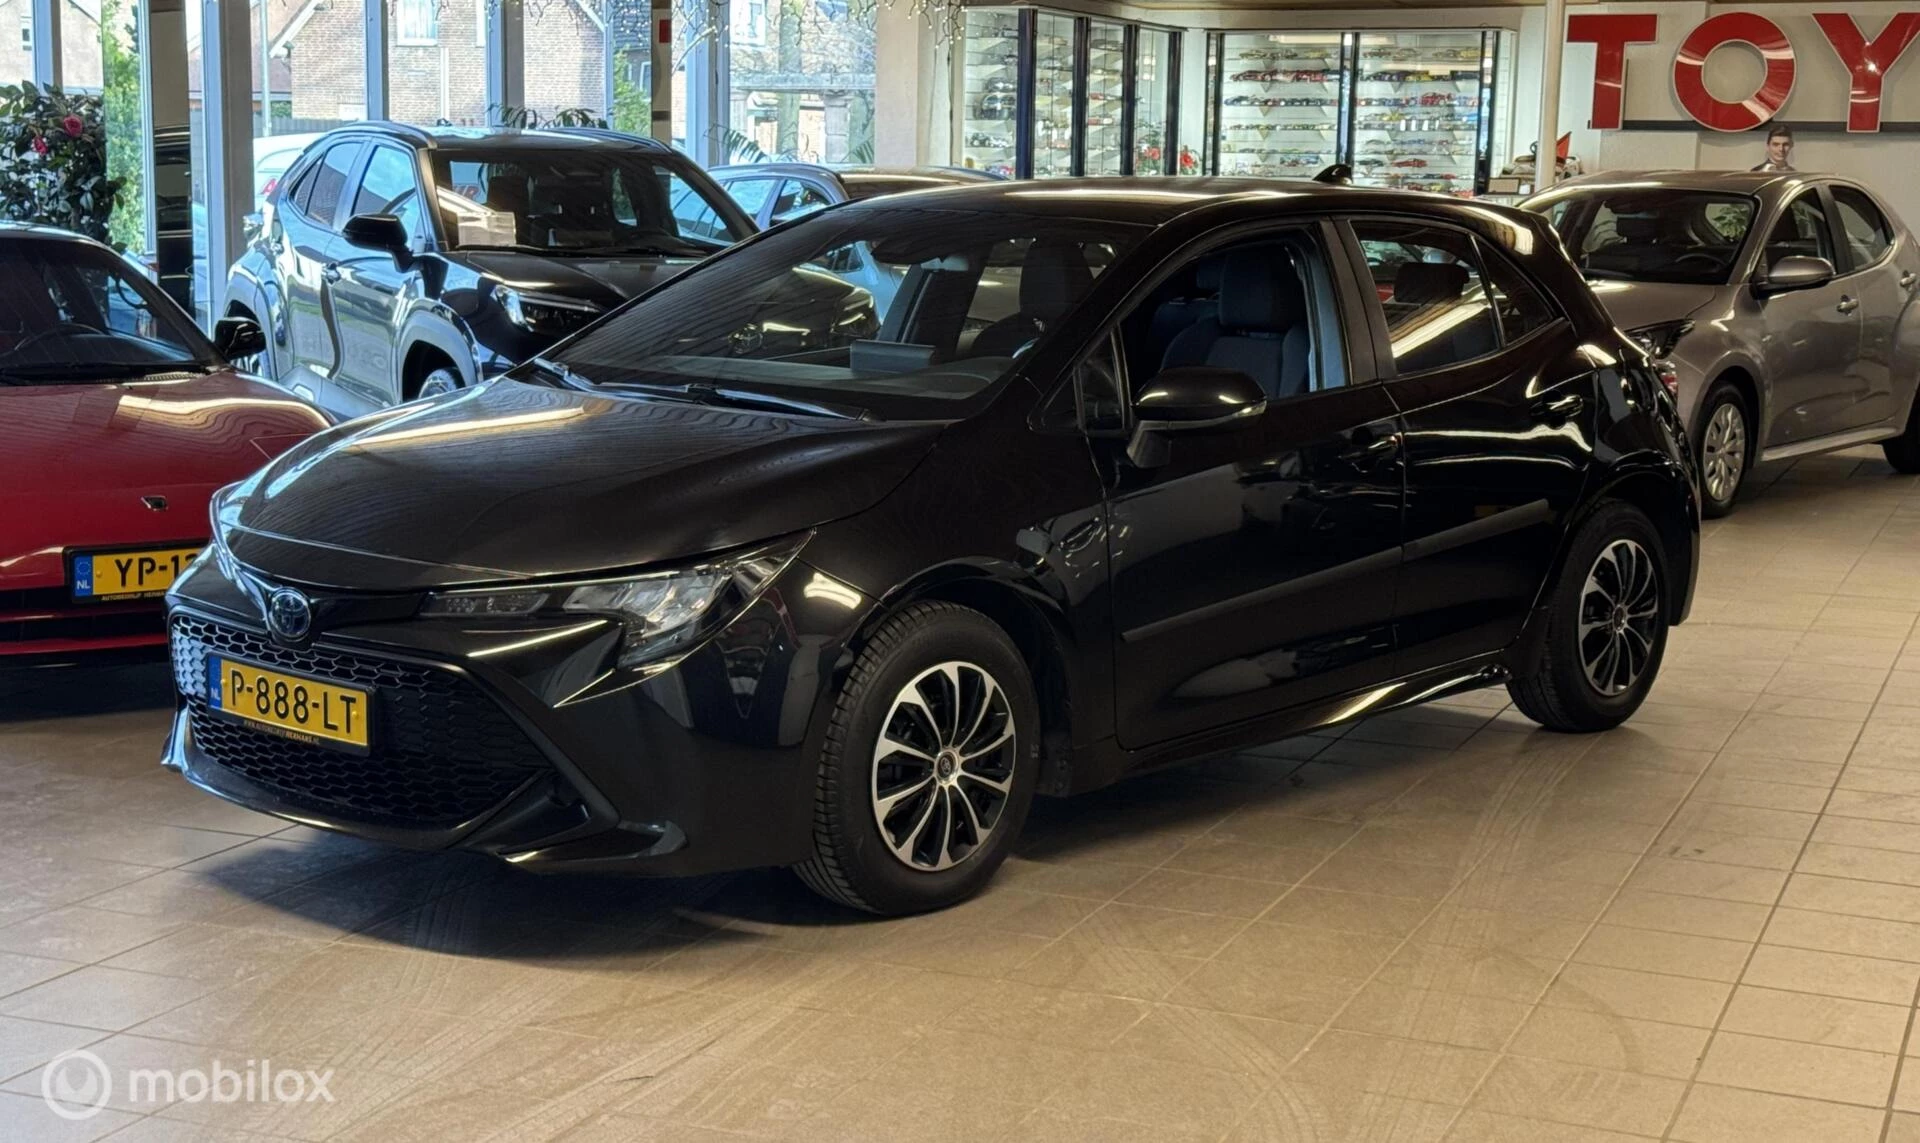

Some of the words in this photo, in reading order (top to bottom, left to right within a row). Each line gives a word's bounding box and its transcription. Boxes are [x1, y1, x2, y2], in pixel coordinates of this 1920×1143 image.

[1567, 12, 1920, 133] TOY
[76, 580, 90, 590] NL
[210, 686, 221, 701] NL
[231, 669, 357, 734] P-888-LT
